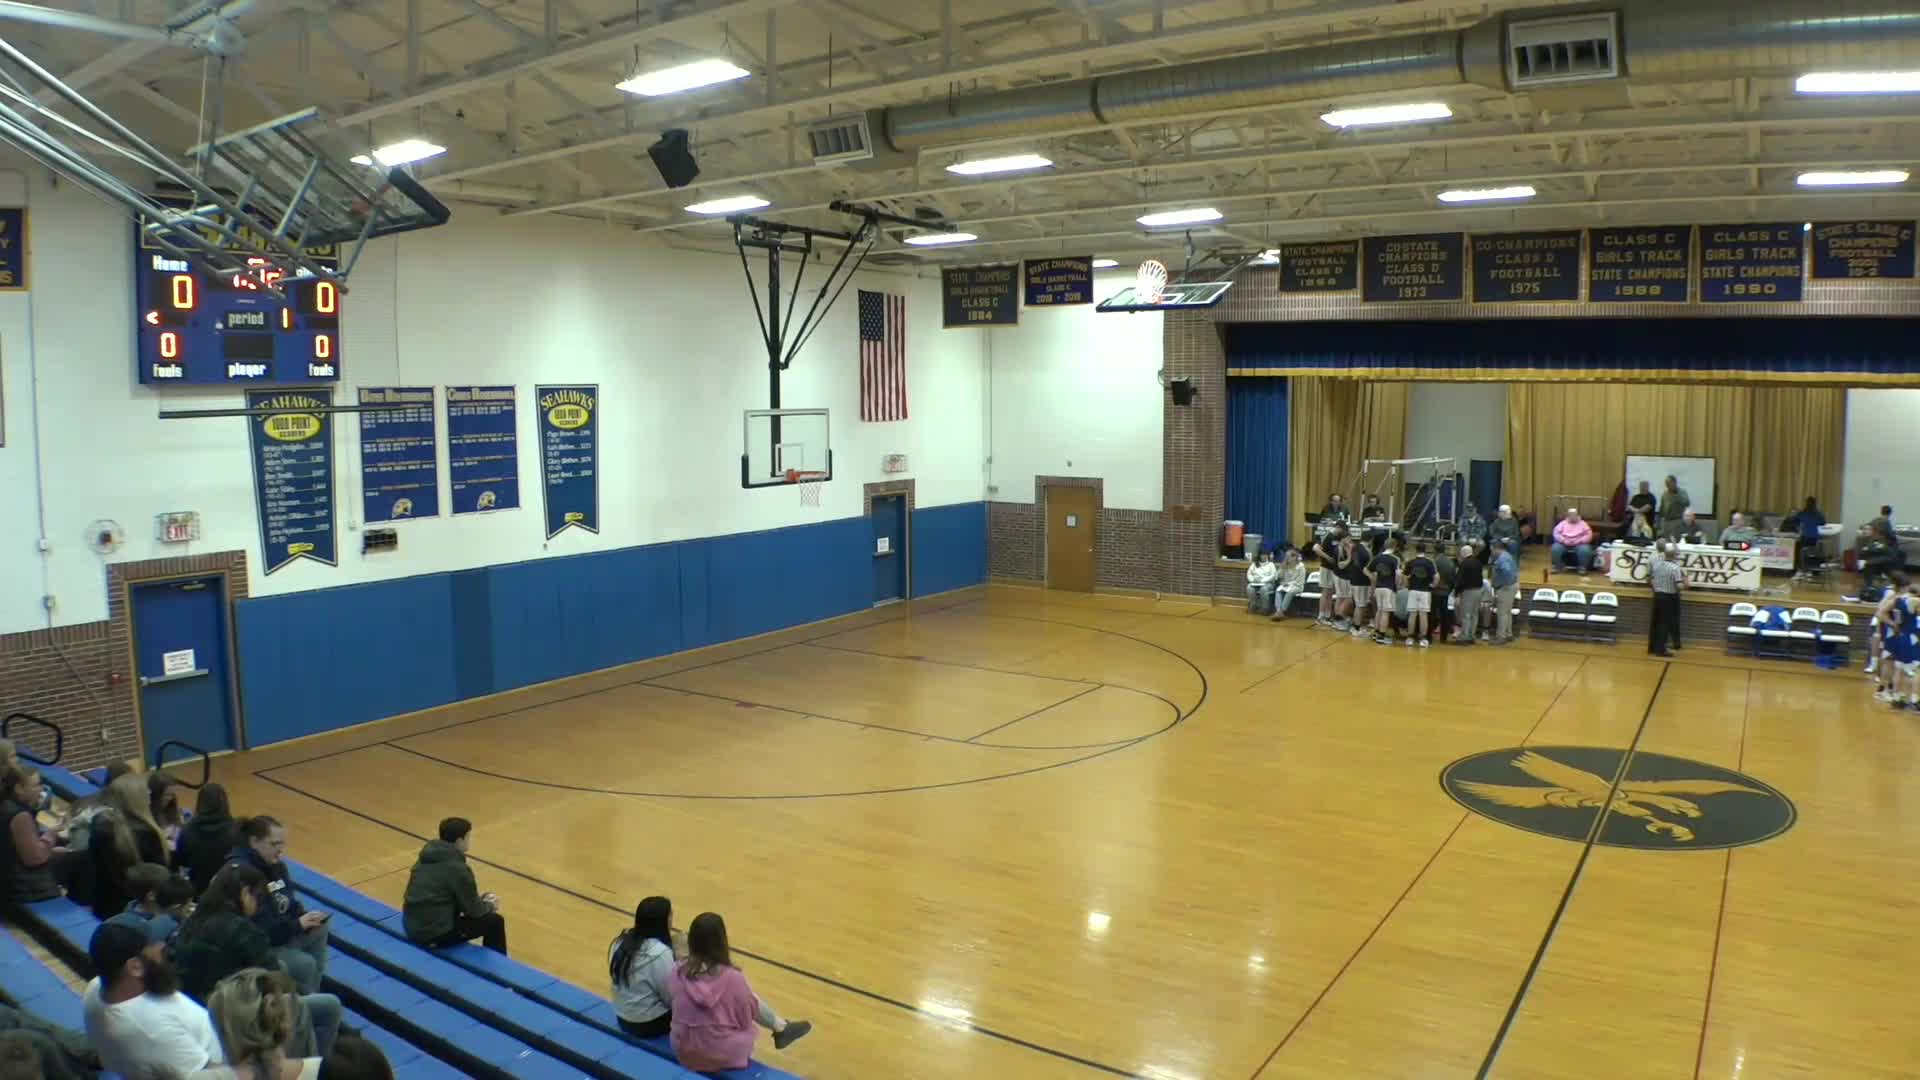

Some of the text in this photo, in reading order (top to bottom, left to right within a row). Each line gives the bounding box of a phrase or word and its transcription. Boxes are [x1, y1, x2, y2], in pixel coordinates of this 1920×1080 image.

[1603, 233, 1675, 246] CLASS C
[1713, 230, 1789, 243] CLASS C
[1378, 251, 1448, 263] CHAMPIONS
[1495, 253, 1538, 265] CLASS
[1596, 250, 1682, 263] GIRLS TRACK
[1705, 247, 1797, 261] GIRLS TRACK
[1386, 263, 1440, 274] CLASS D
[1490, 268, 1561, 280] FOOTBALL
[1592, 267, 1686, 281] STATE CHAMPIONS
[1703, 265, 1800, 278] STATE CHAMPIONS
[1383, 275, 1445, 286] FOOTBALL
[172, 274, 194, 310] 0
[1510, 282, 1541, 294] 1975
[316, 281, 335, 314] 0
[227, 312, 265, 327] period
[160, 332, 177, 358] 0
[314, 334, 330, 359] 0
[227, 362, 267, 379] player
[540, 390, 594, 411] SEAHAWKS
[1615, 550, 1757, 573] SEHAWK
